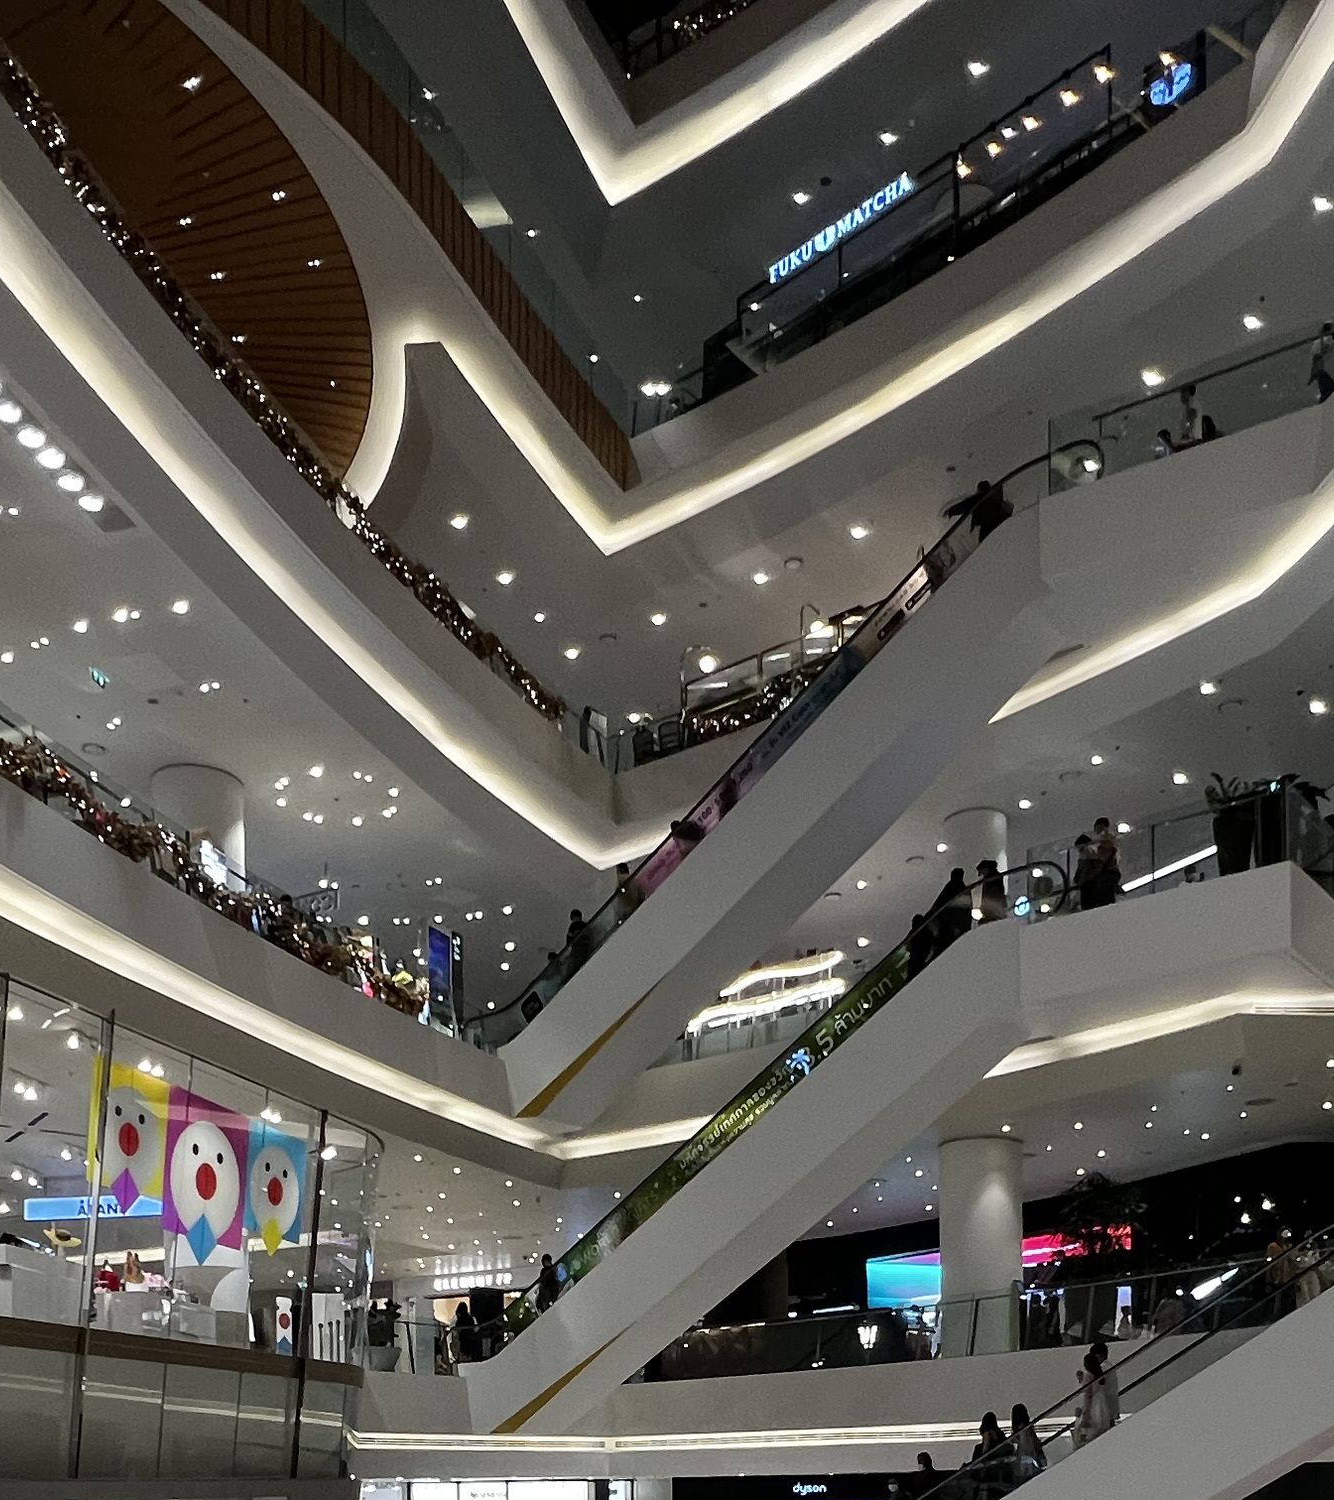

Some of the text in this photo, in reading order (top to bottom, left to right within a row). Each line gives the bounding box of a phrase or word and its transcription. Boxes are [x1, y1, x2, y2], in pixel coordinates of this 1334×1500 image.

[769, 171, 913, 284] FUKU MATCHA
[793, 1482, 827, 1495] dyson
